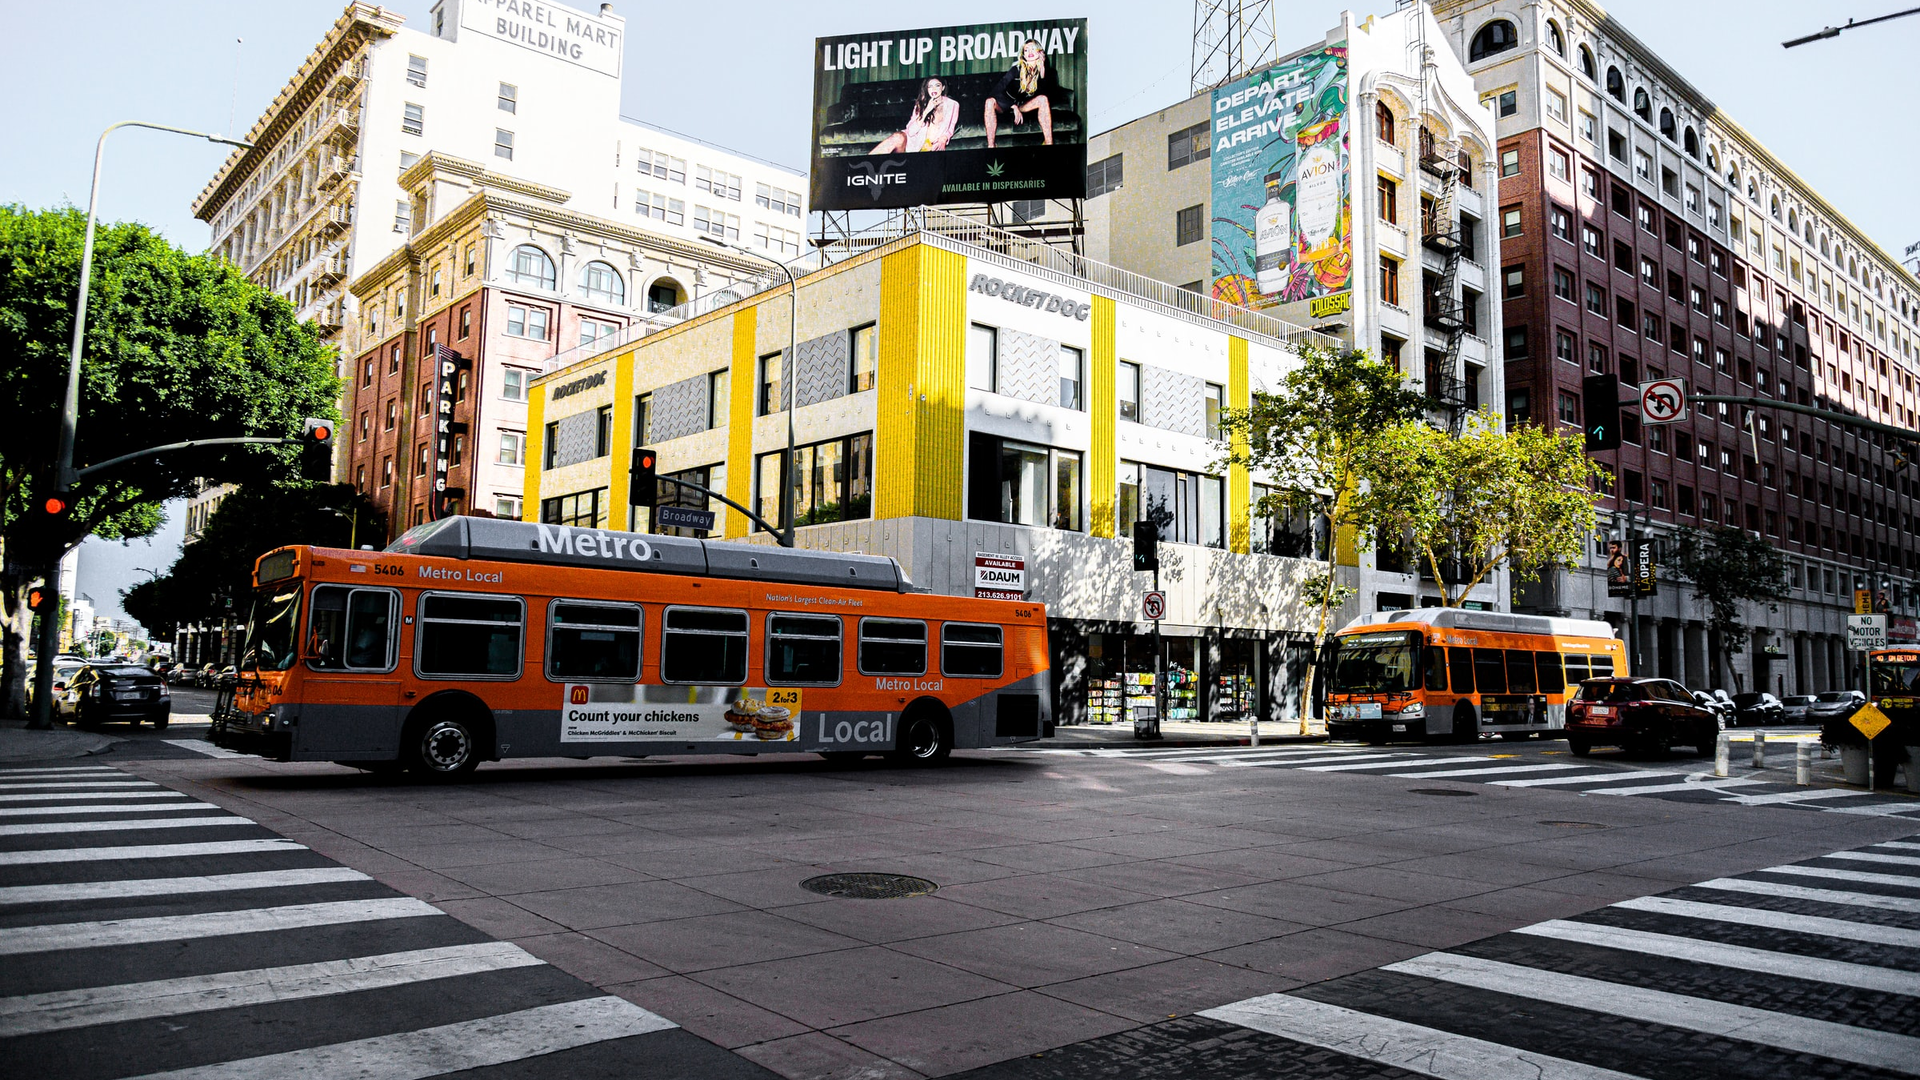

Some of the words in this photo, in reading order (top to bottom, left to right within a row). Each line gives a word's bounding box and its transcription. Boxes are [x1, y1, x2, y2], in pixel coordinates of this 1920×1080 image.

[478, 0, 556, 28] PAREL
[566, 17, 618, 49] MART
[496, 17, 583, 60] BUILDING
[824, 40, 893, 71] LIGHT
[899, 37, 933, 65] UP
[940, 27, 1079, 63] BROADWAY
[1216, 87, 1315, 133] ELEVATE.
[1216, 111, 1302, 152] ARRIVE.
[847, 173, 907, 187] IGNITE
[942, 183, 980, 193] AVAILABLE
[982, 182, 990, 190] IN
[992, 180, 1045, 190] DISPENSARIES
[1310, 291, 1352, 318] COLOSSAL
[436, 361, 456, 492] PARKING
[662, 510, 711, 526] Broadway
[538, 525, 652, 561] Metro
[374, 564, 404, 576] 5406
[985, 560, 1016, 568] AVAILABLE
[418, 565, 462, 581] Metro
[465, 569, 502, 583] Local
[989, 571, 1019, 583] DAUM
[766, 593, 792, 603] Nation's
[794, 594, 816, 606] Largest
[818, 597, 847, 606] Clean-Air
[848, 598, 863, 607] Fleet
[977, 591, 1021, 600] 213.626.9101
[1015, 609, 1032, 618] 5406
[1860, 616, 1872, 625] NO
[1853, 627, 1880, 636] MOTOR
[876, 677, 912, 691] Metro
[914, 679, 943, 691] Local
[569, 710, 609, 722] Count
[612, 711, 641, 725] your
[644, 710, 699, 722] chickens
[819, 713, 892, 743] Local
